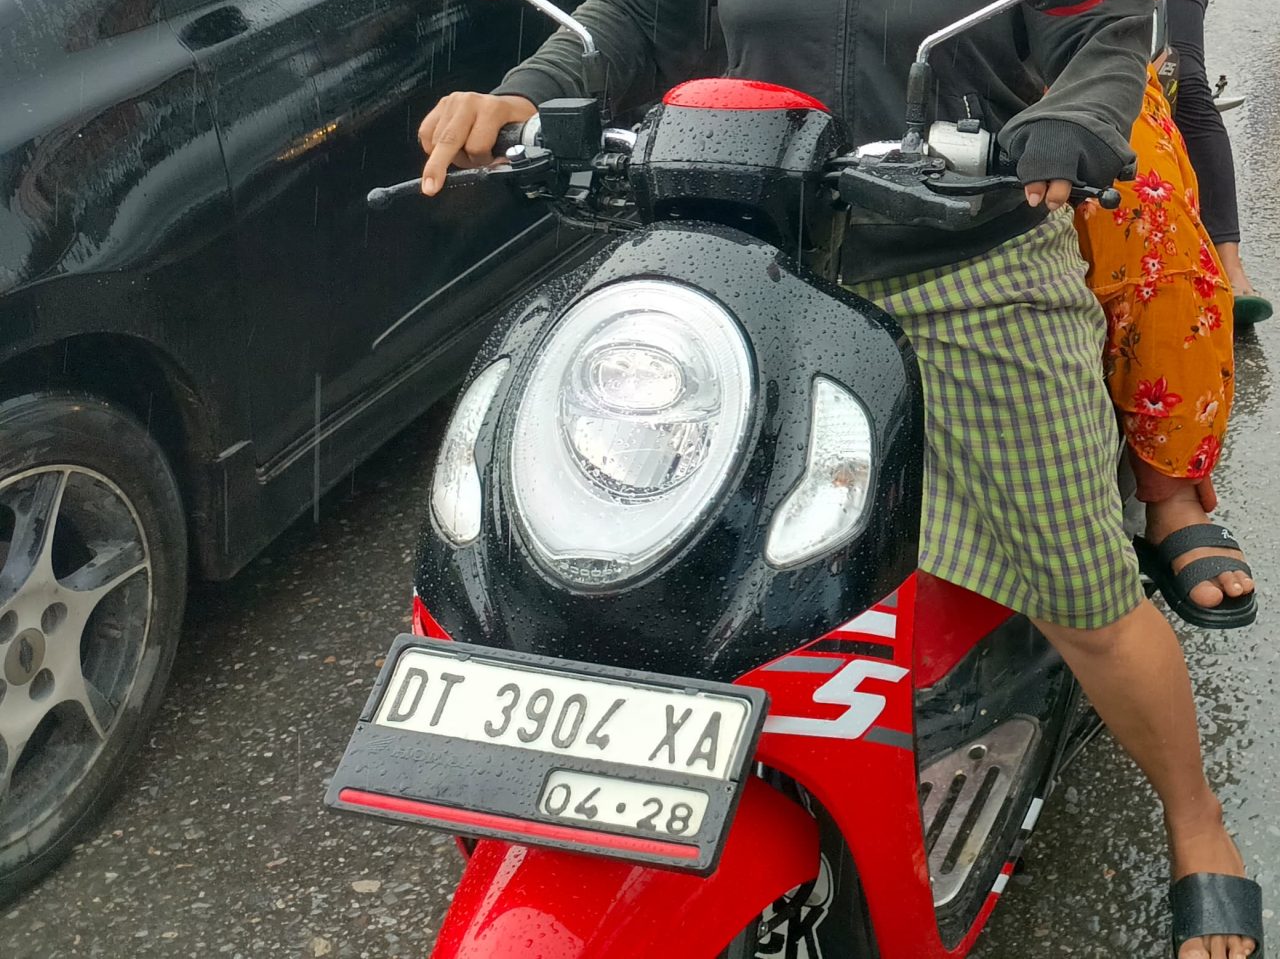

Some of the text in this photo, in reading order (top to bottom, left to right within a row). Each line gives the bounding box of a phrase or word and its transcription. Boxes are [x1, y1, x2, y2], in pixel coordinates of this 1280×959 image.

[386, 667, 722, 771] DT 3904 XA
